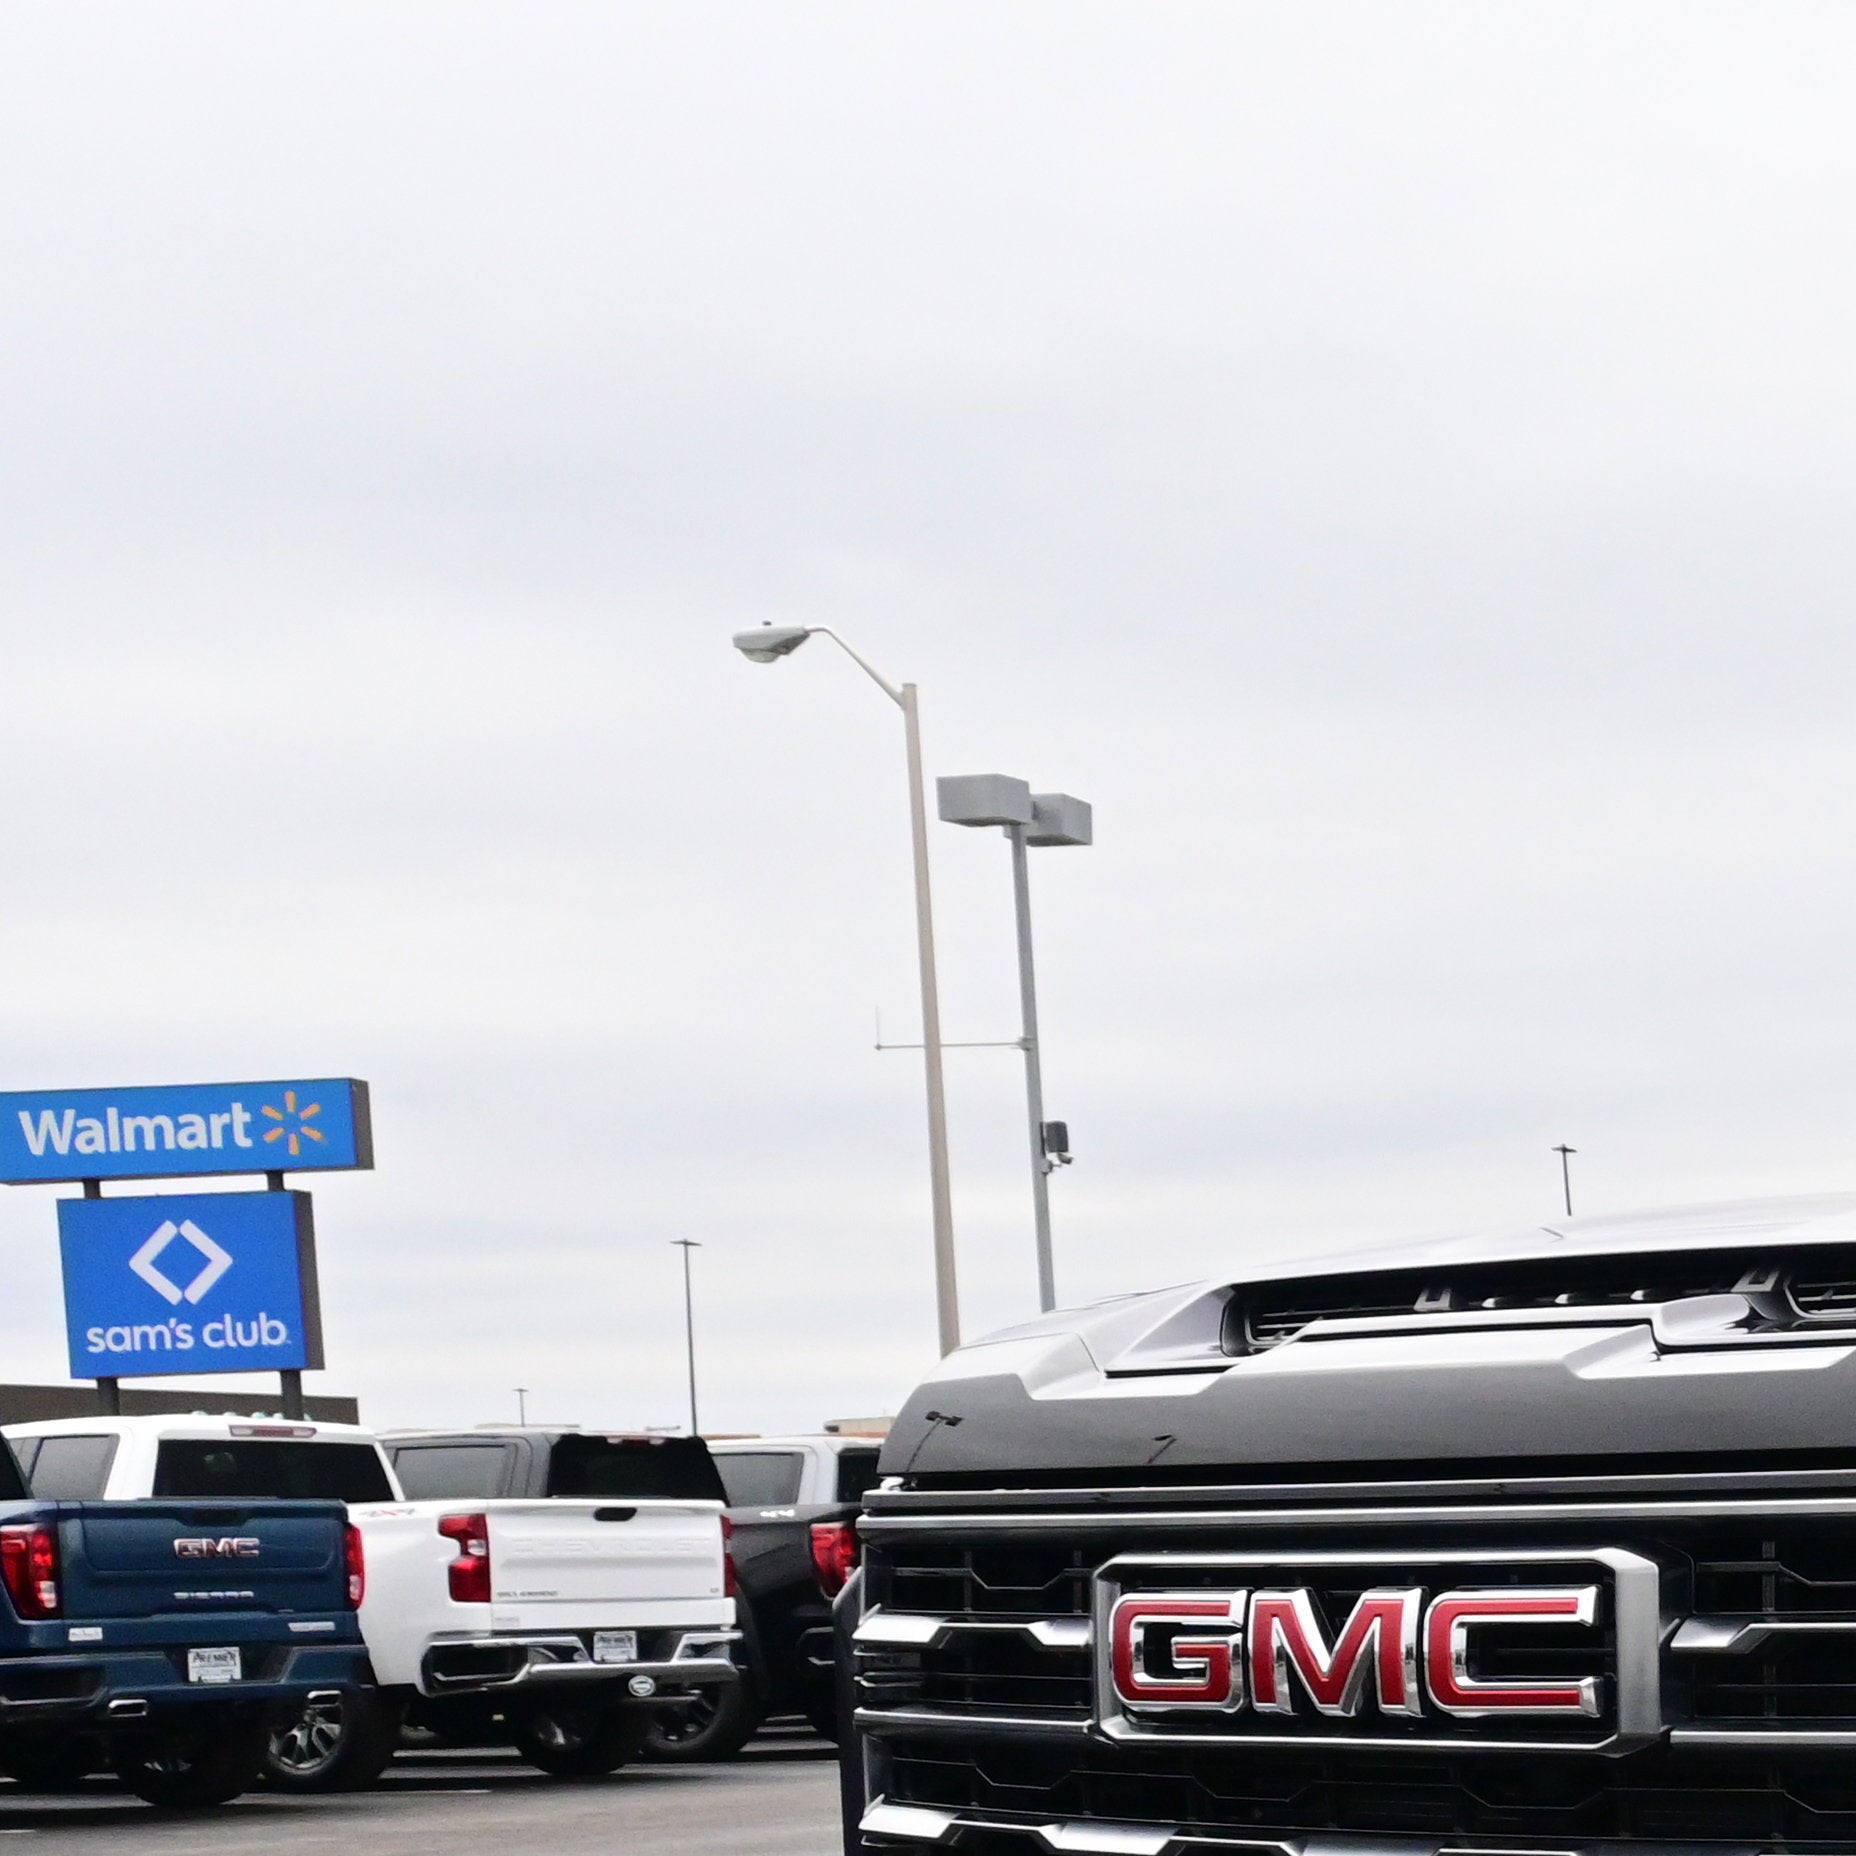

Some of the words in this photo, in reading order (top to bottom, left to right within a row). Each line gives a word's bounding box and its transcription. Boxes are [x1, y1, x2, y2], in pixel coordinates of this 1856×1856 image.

[18, 1102, 253, 1156] Walmart
[86, 1317, 194, 1354] sam's
[202, 1312, 287, 1348] club
[174, 1537, 260, 1558] GMC
[1111, 1585, 1601, 1717] GMC
